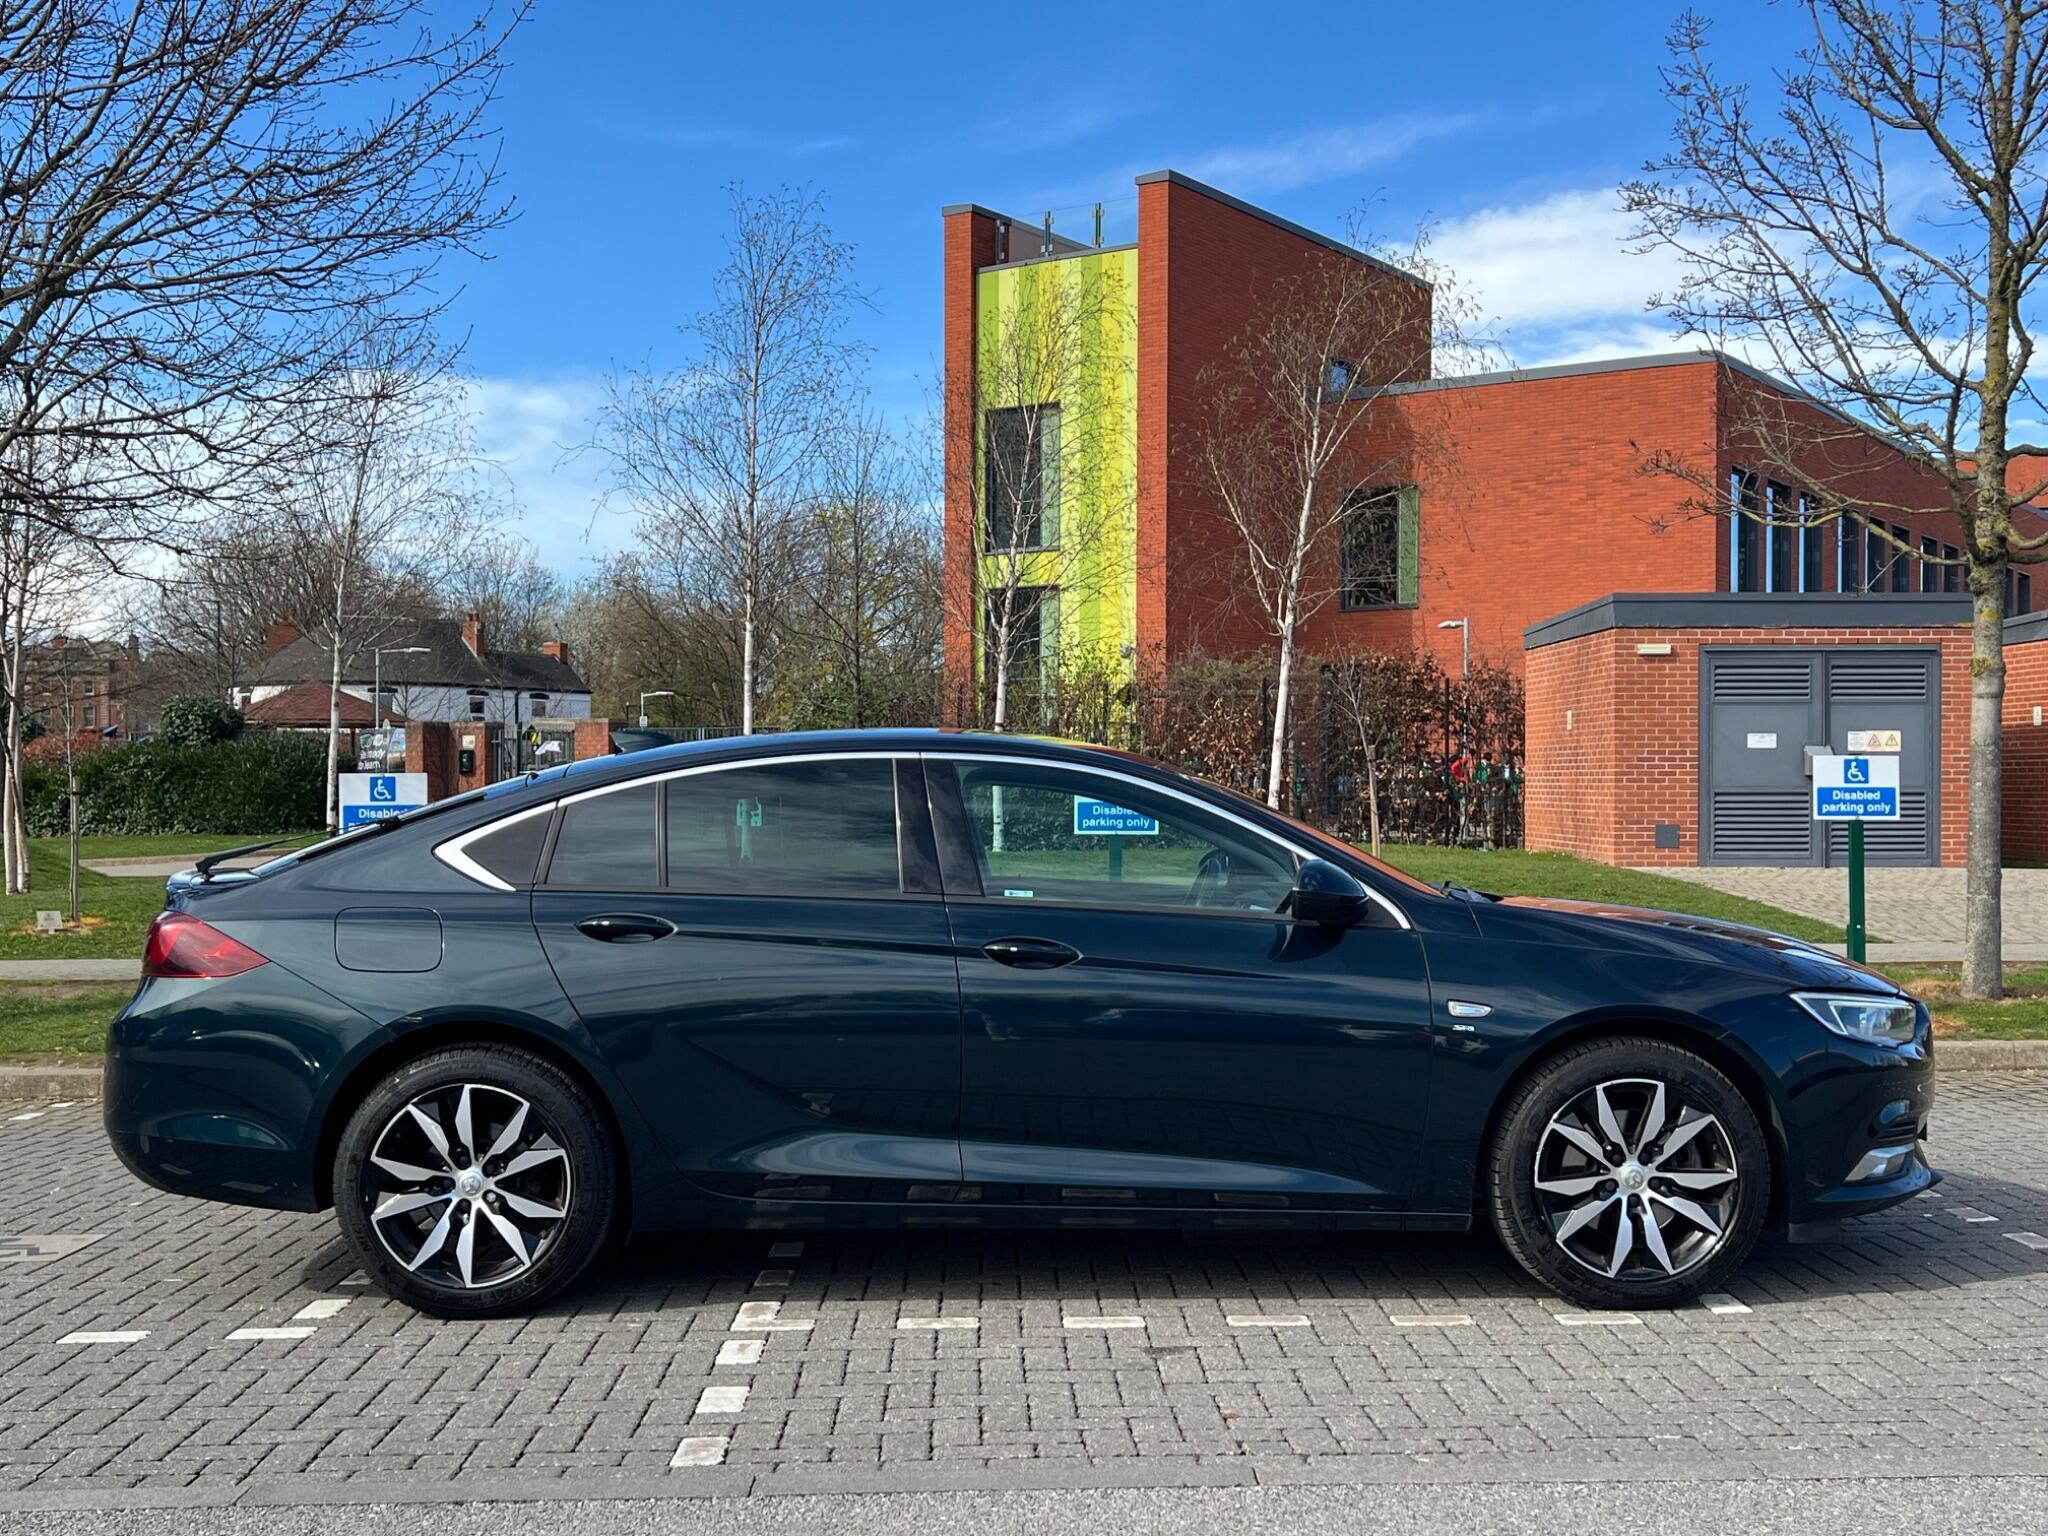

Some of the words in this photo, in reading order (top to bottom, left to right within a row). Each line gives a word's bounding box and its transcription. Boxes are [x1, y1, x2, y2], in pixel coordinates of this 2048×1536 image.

[1832, 790, 1880, 800] Disabled
[358, 808, 408, 818] Disable
[1092, 805, 1140, 815] Disable
[1822, 802, 1864, 814] parking
[1867, 802, 1891, 814] only
[1082, 817, 1124, 829] parking
[1126, 817, 1150, 829] only
